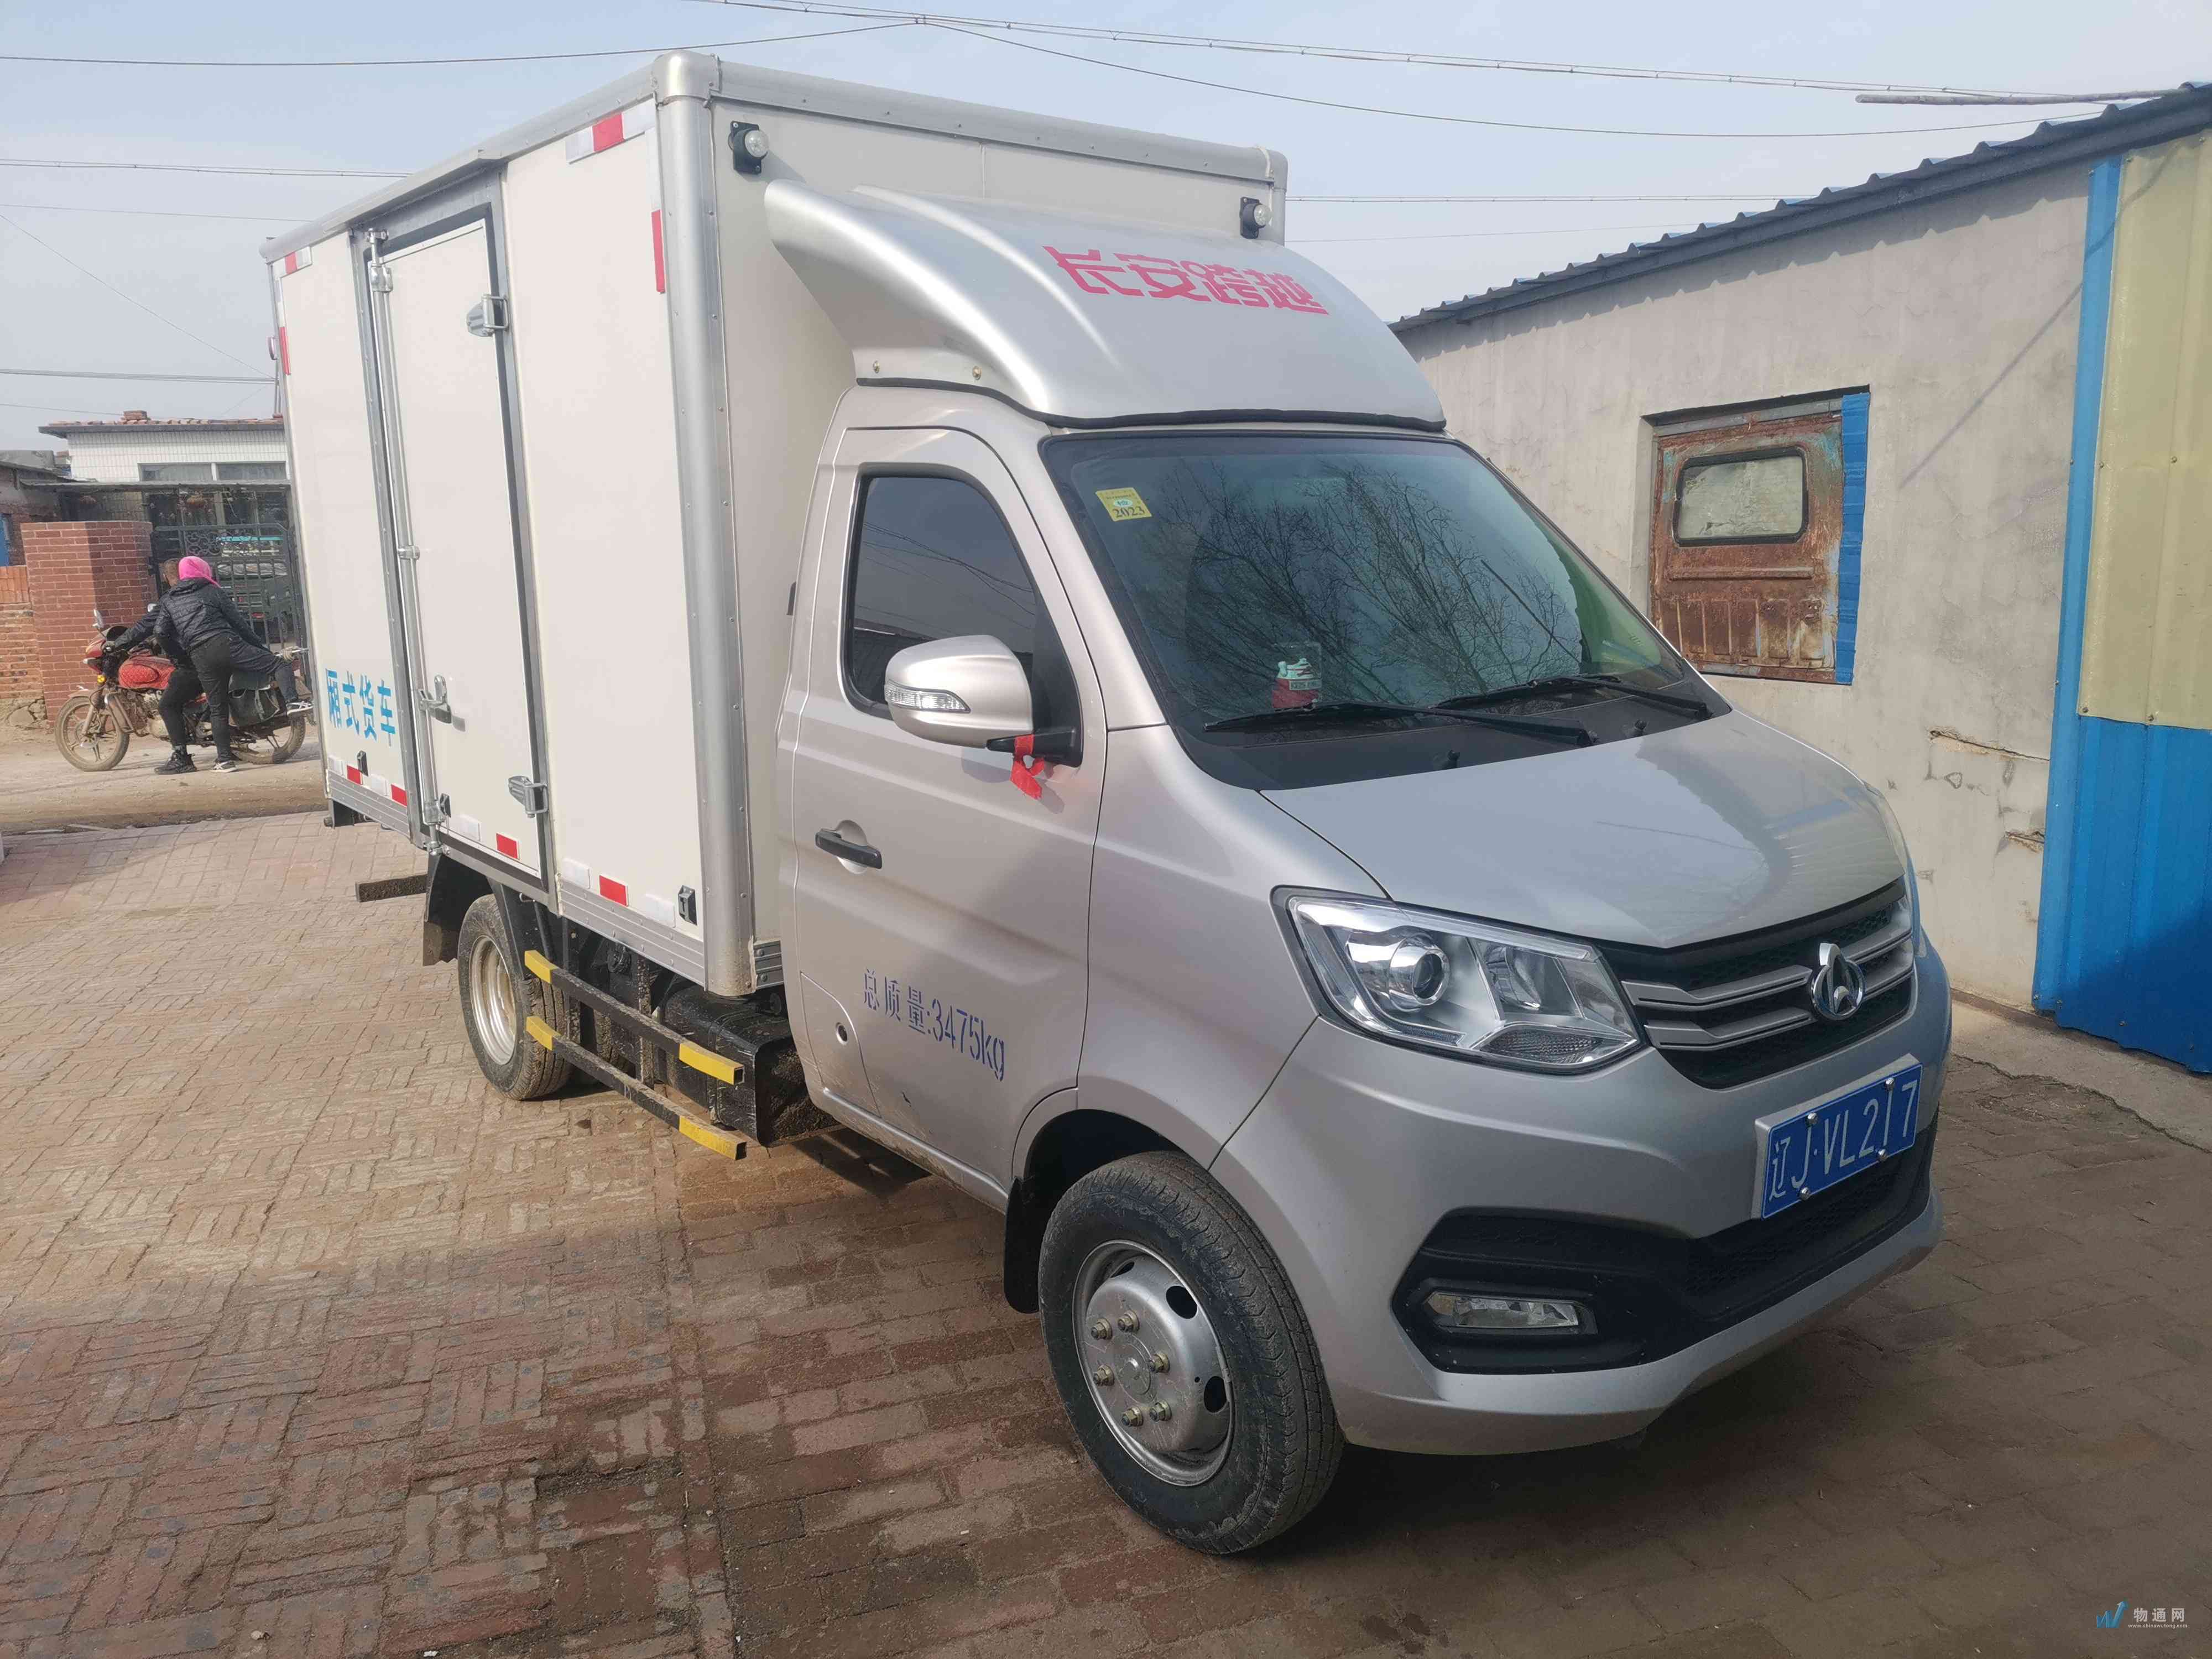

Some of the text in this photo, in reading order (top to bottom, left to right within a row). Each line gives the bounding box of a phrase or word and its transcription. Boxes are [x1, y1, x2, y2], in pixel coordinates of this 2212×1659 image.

[1043, 246, 1329, 315] 长安跨越
[1113, 506, 1145, 518] 2023
[325, 668, 396, 747] 厢式货车
